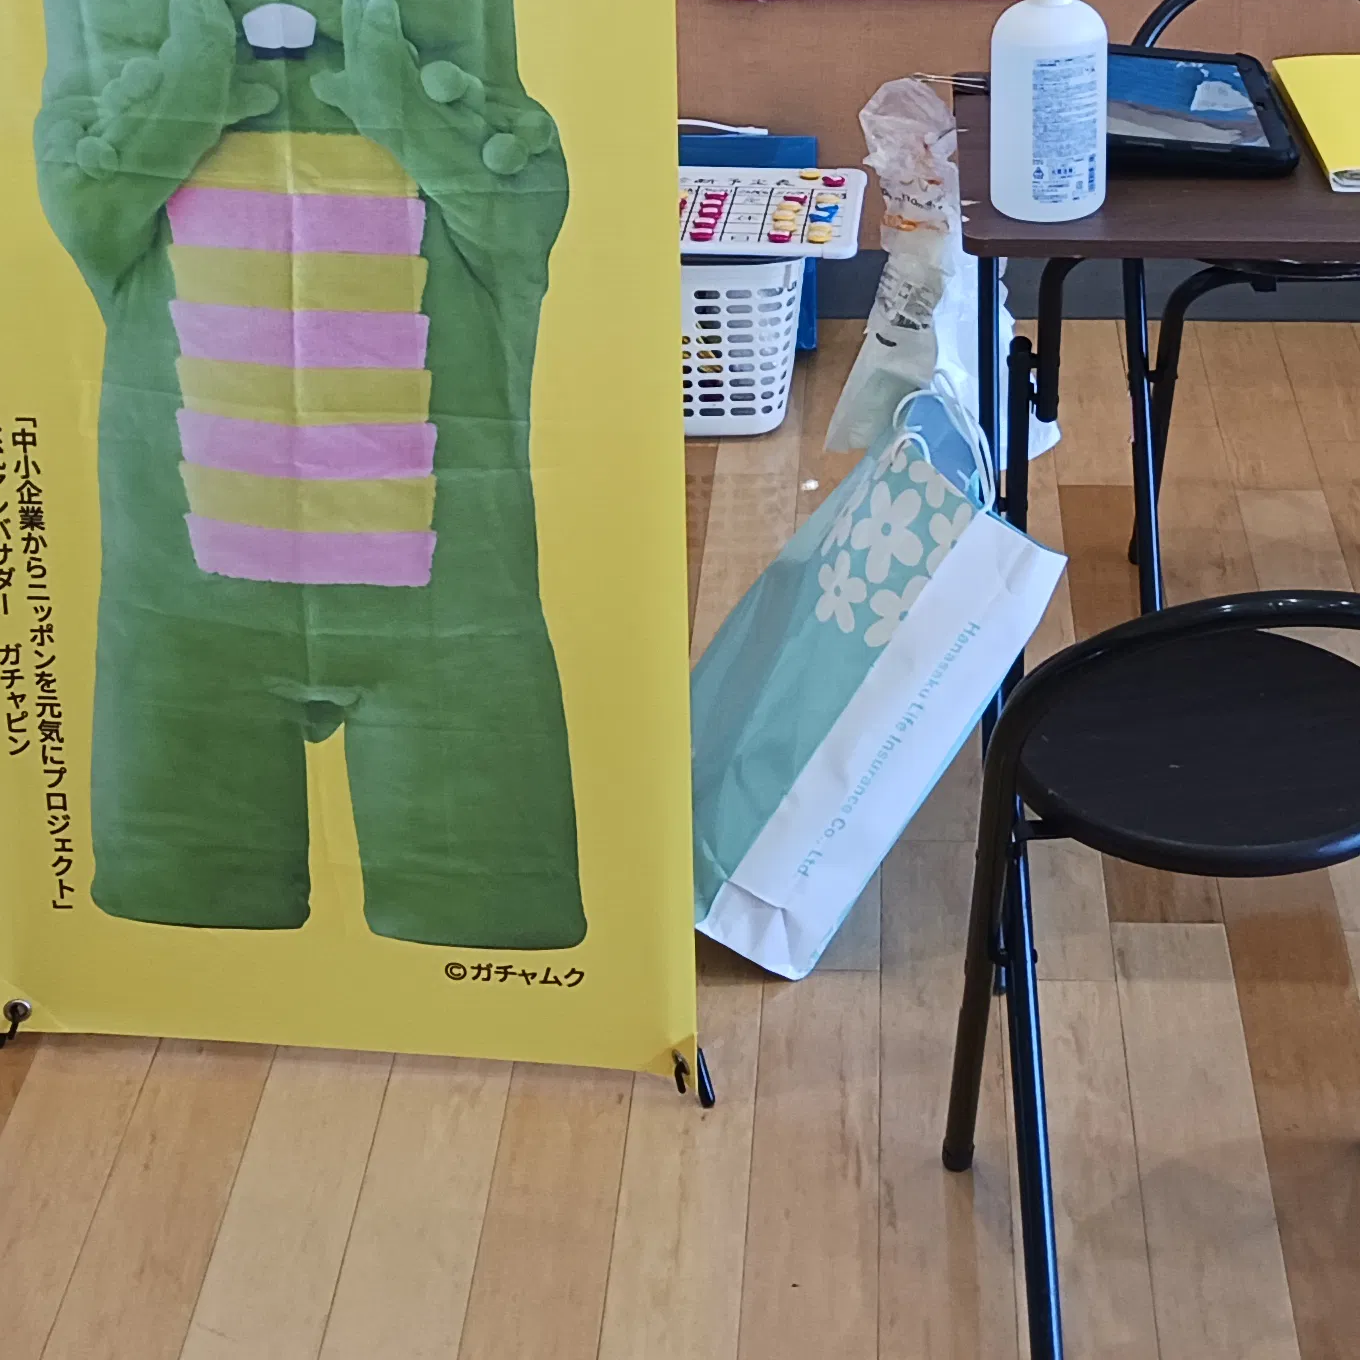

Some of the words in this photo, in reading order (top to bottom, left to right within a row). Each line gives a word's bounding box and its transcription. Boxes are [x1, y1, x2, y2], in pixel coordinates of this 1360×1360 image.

[11, 415, 75, 911] 「中小企業からニッポンを元気にプロジェクト」
[917, 620, 981, 700] Hanasaku
[895, 701, 925, 734] Life
[840, 734, 903, 816] Insurance
